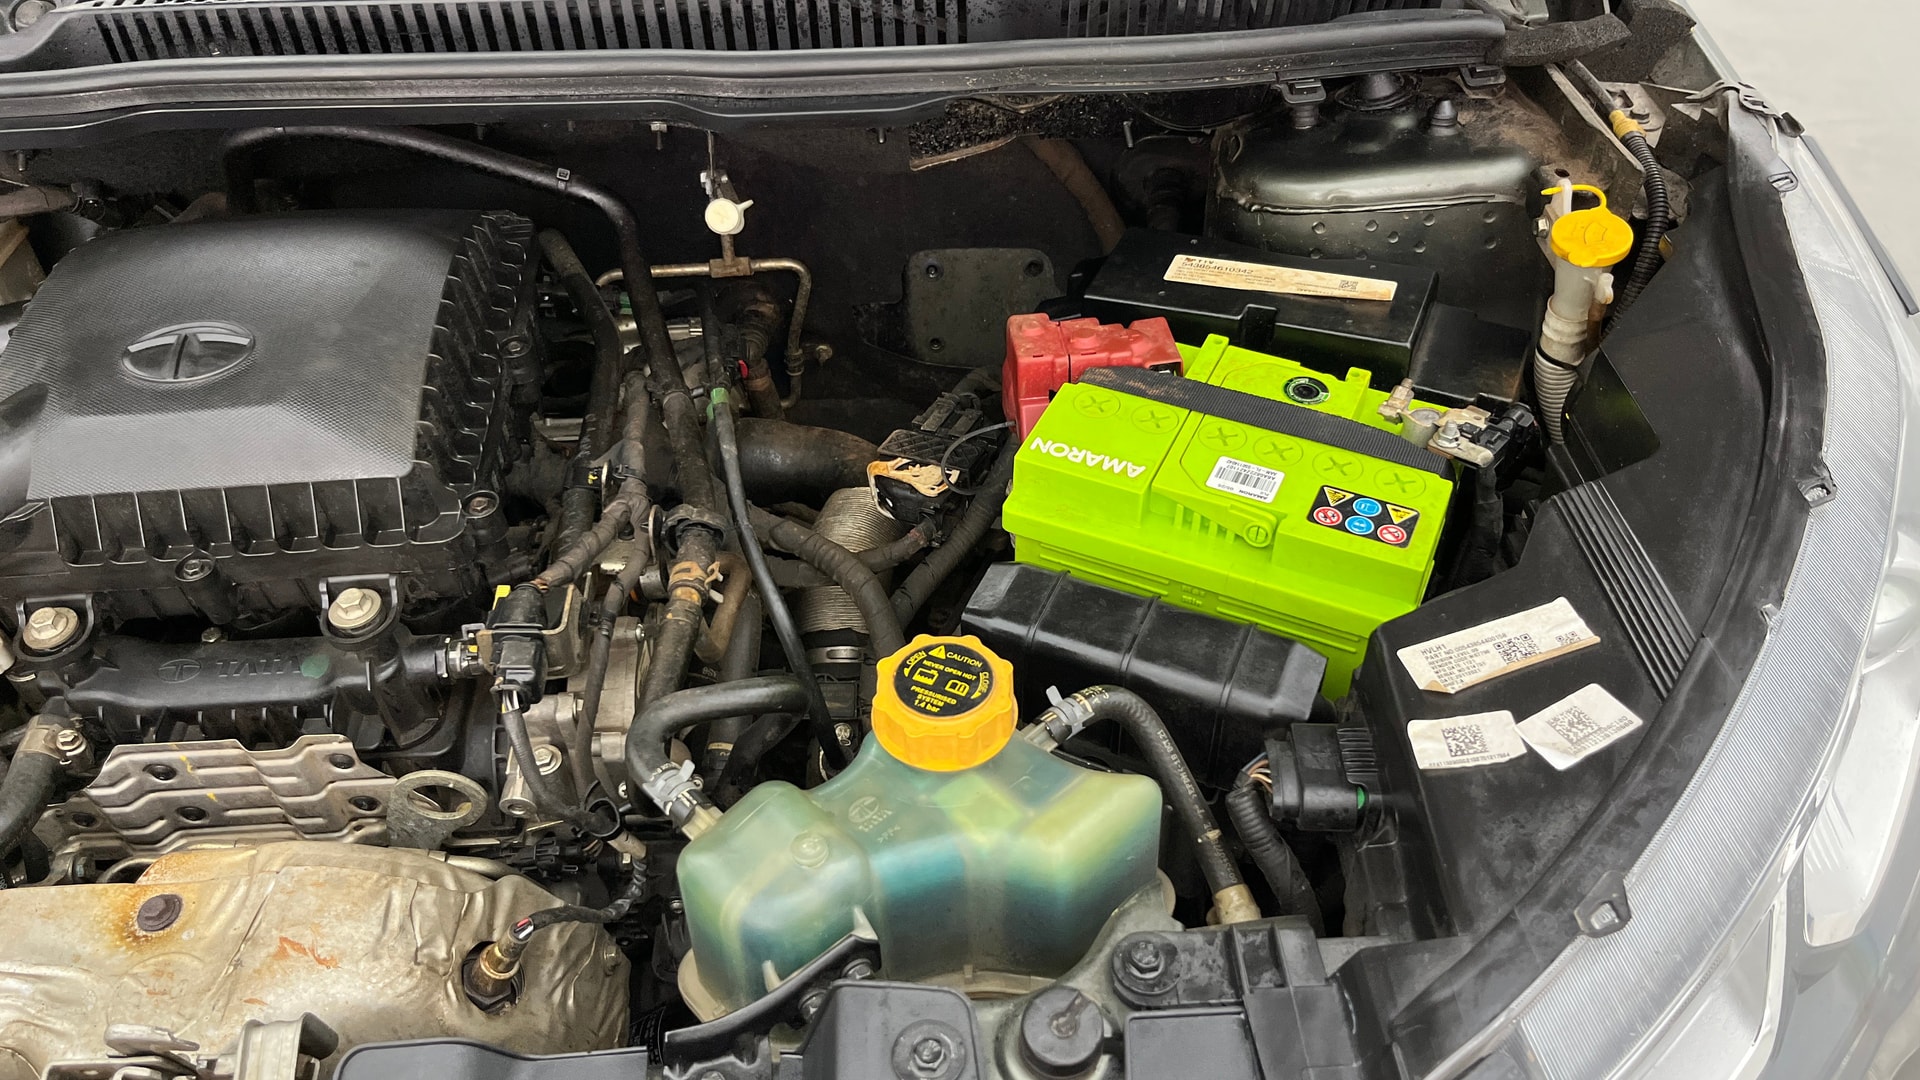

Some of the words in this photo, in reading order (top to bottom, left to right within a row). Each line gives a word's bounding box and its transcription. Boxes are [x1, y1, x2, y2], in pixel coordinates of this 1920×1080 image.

[1030, 436, 1146, 478] AMARON
[1239, 489, 1268, 500] AMARON
[1420, 643, 1447, 656] HVLH1
[1424, 652, 1443, 660] PART
[906, 650, 927, 666] OPEN
[946, 651, 983, 668] CAUTION
[922, 659, 945, 671] NEVER
[944, 666, 962, 677] OPEN
[962, 671, 977, 681] HOT
[910, 685, 957, 705] PRESSURISED
[916, 693, 944, 707] SYSTEM
[914, 699, 926, 709] 1.4
[926, 704, 940, 713] bar
